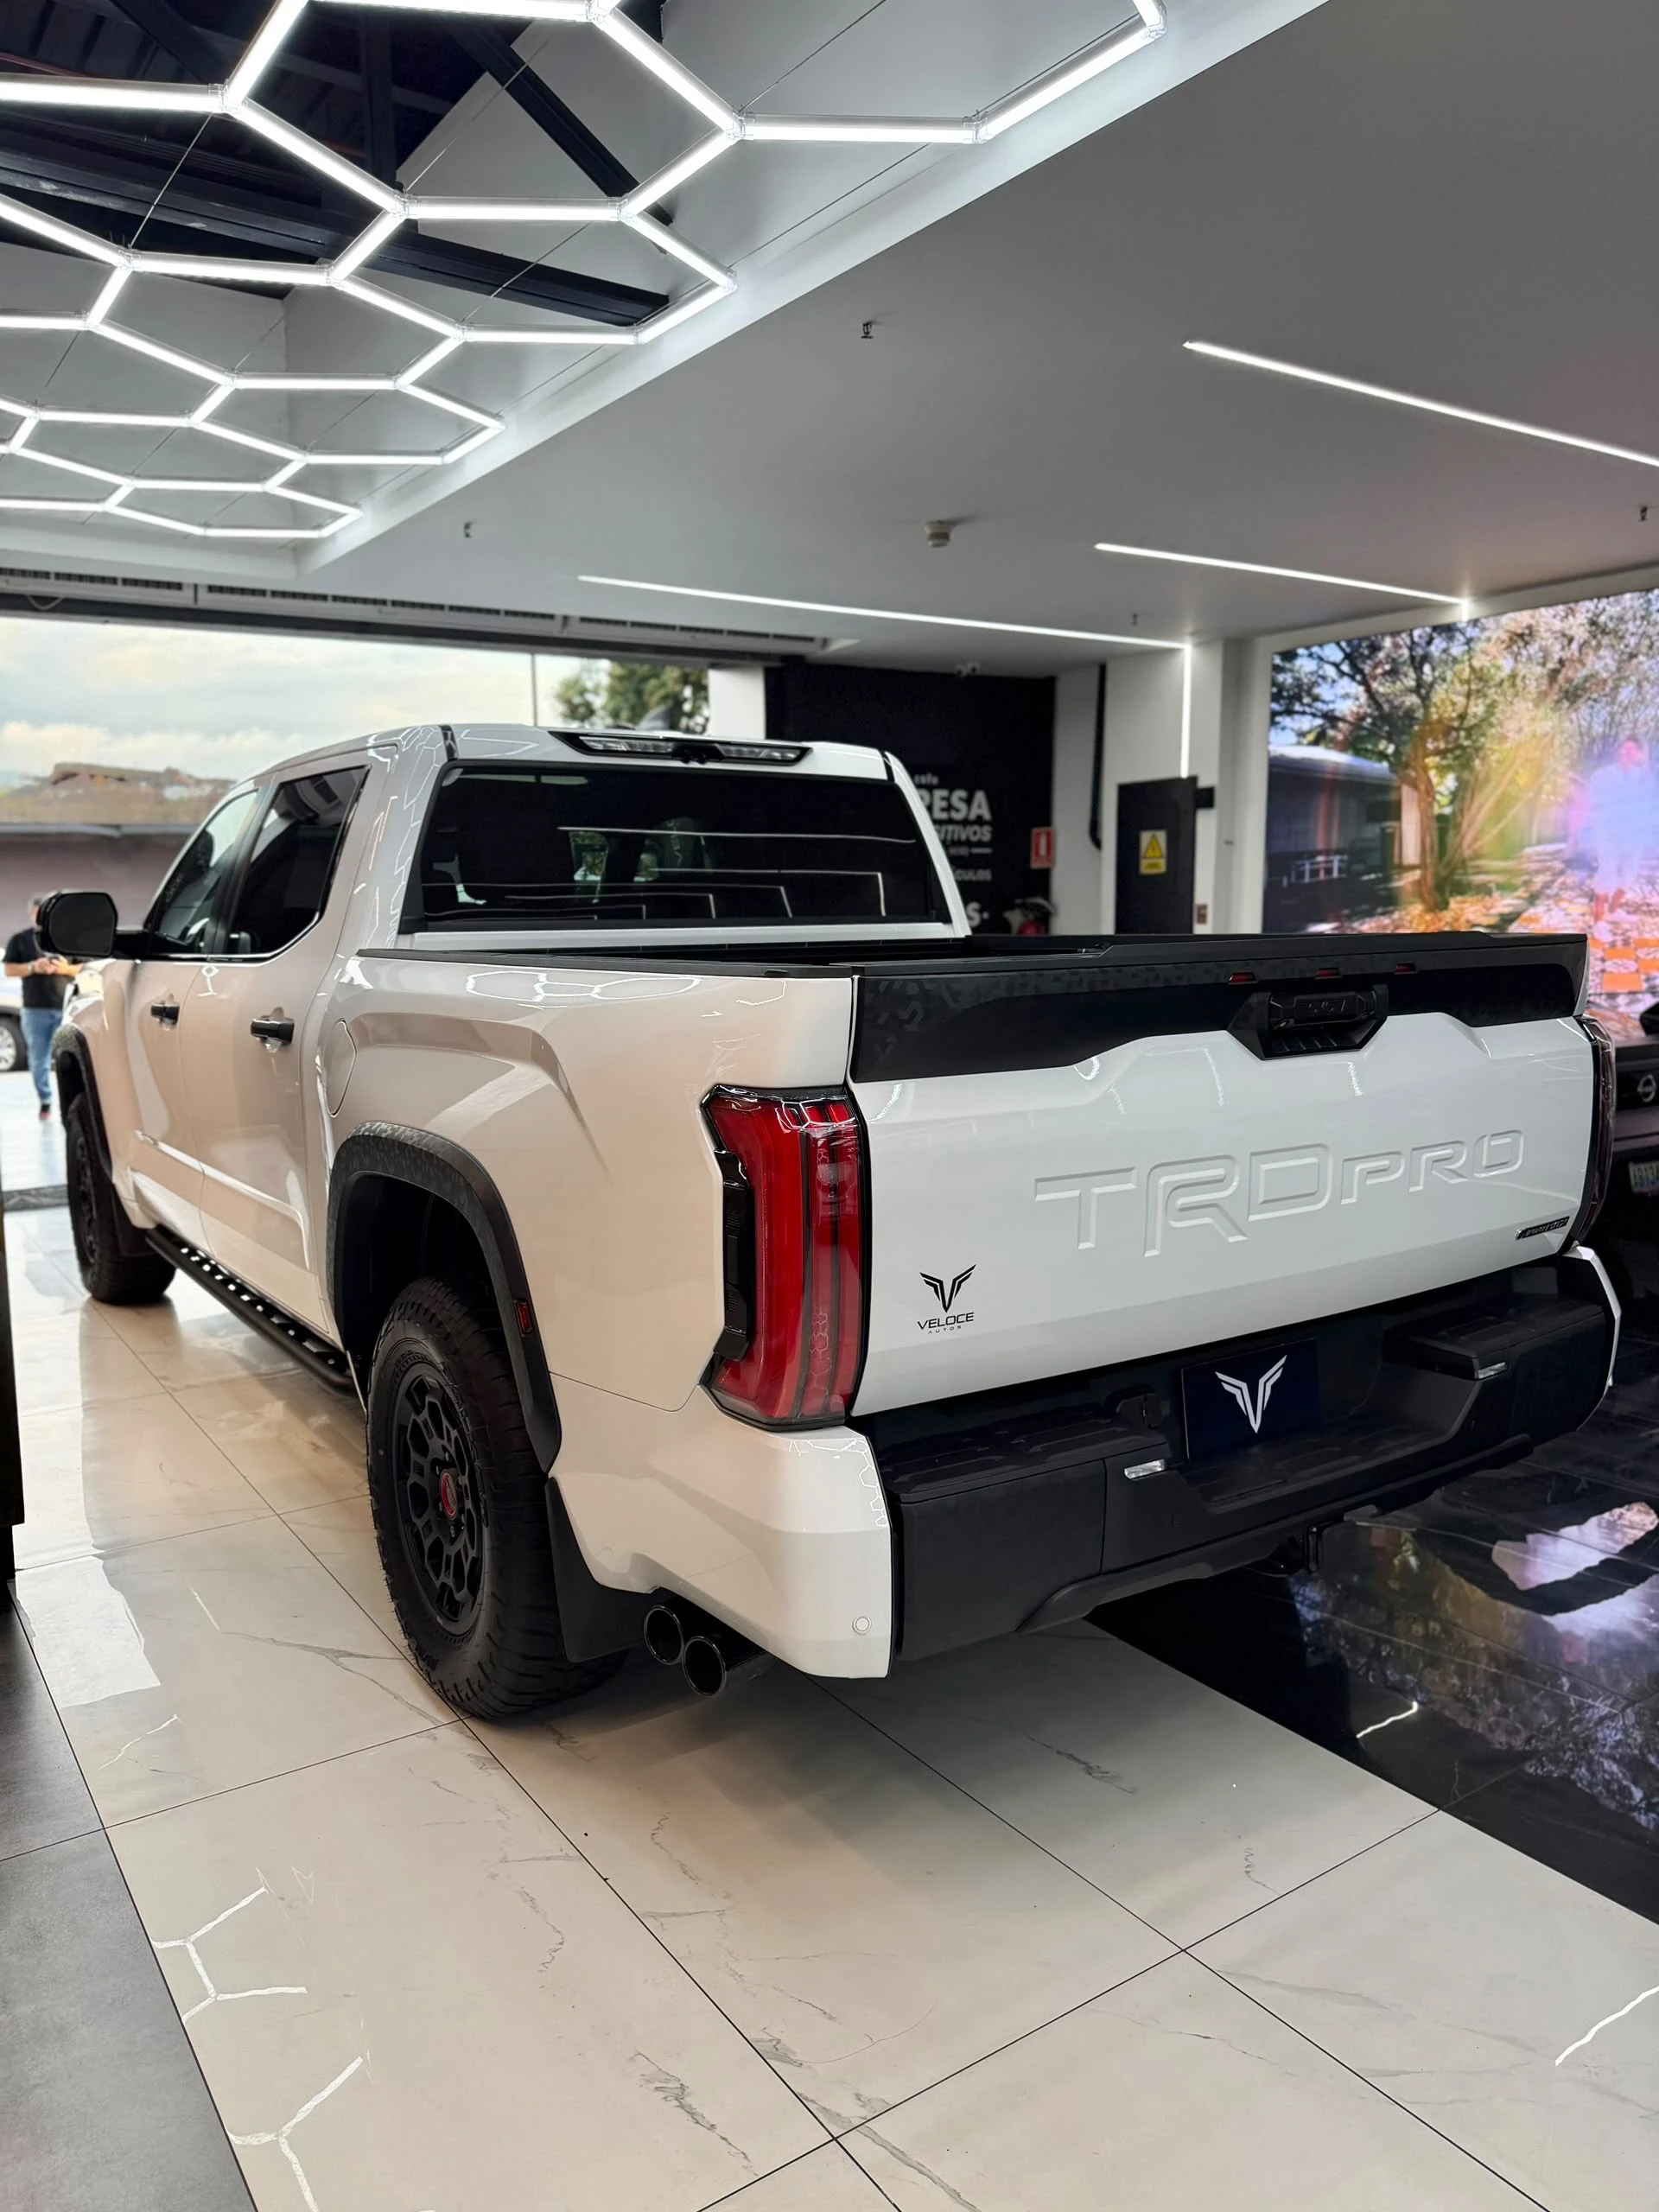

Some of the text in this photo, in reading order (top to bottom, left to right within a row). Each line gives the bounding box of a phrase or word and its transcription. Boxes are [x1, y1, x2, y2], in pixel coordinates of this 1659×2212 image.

[1034, 1130, 1523, 1257] TRD PRO
[918, 1313, 975, 1330] VELOCE
[928, 1325, 962, 1334] AUTOS
